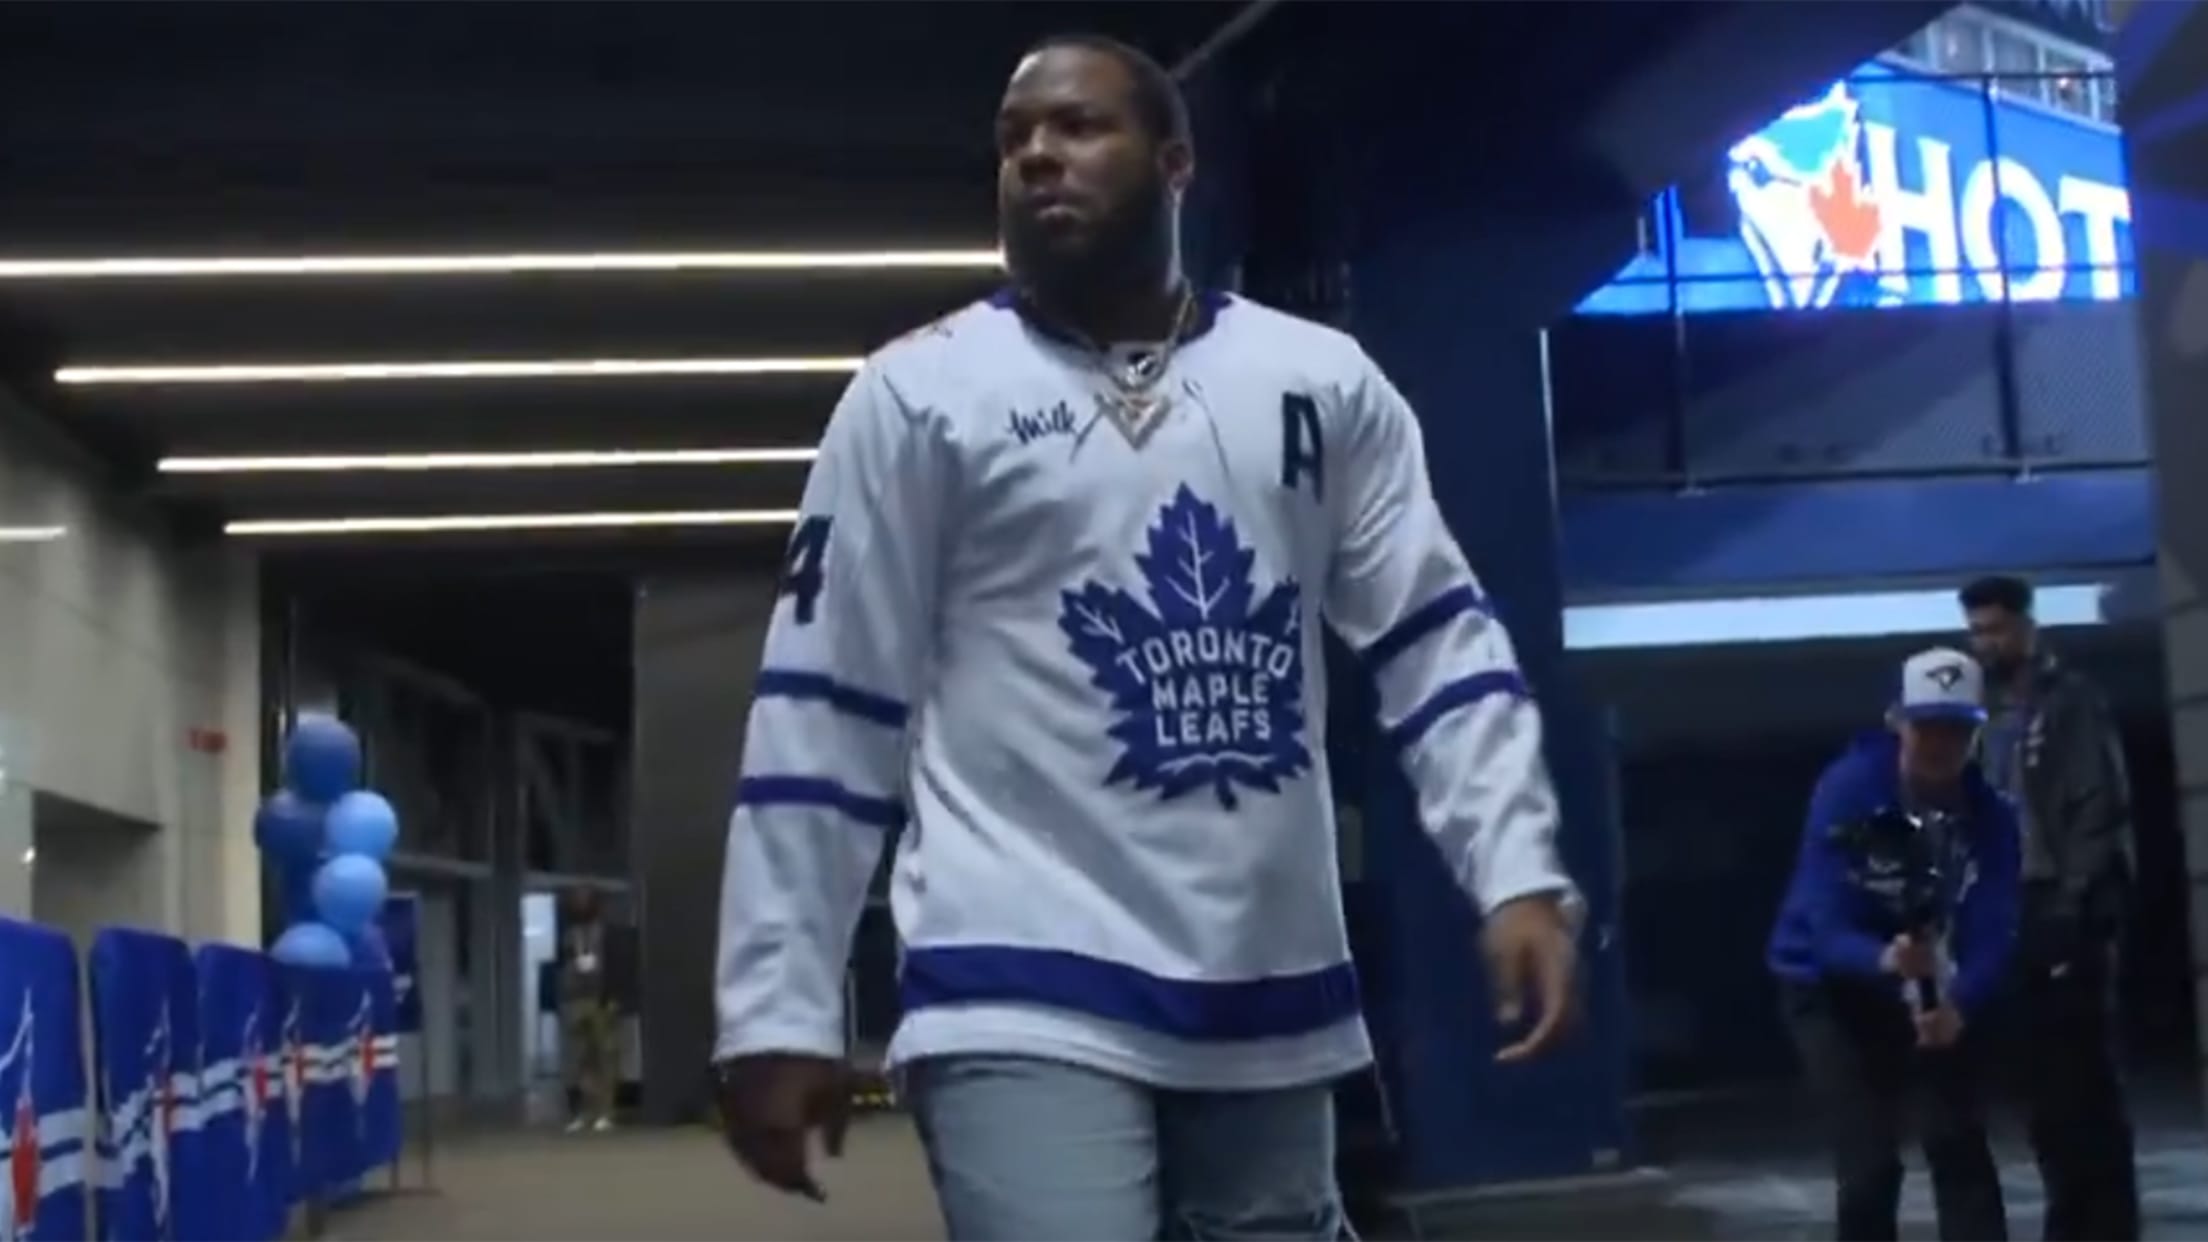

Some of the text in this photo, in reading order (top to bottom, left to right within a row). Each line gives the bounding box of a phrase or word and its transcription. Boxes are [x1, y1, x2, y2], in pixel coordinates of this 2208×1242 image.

[1865, 119, 2131, 303] HOT
[1282, 391, 1323, 505] A
[1115, 626, 1294, 685] TORONTO
[1152, 672, 1270, 710] MAPLE
[1155, 708, 1271, 747] LEAFS
